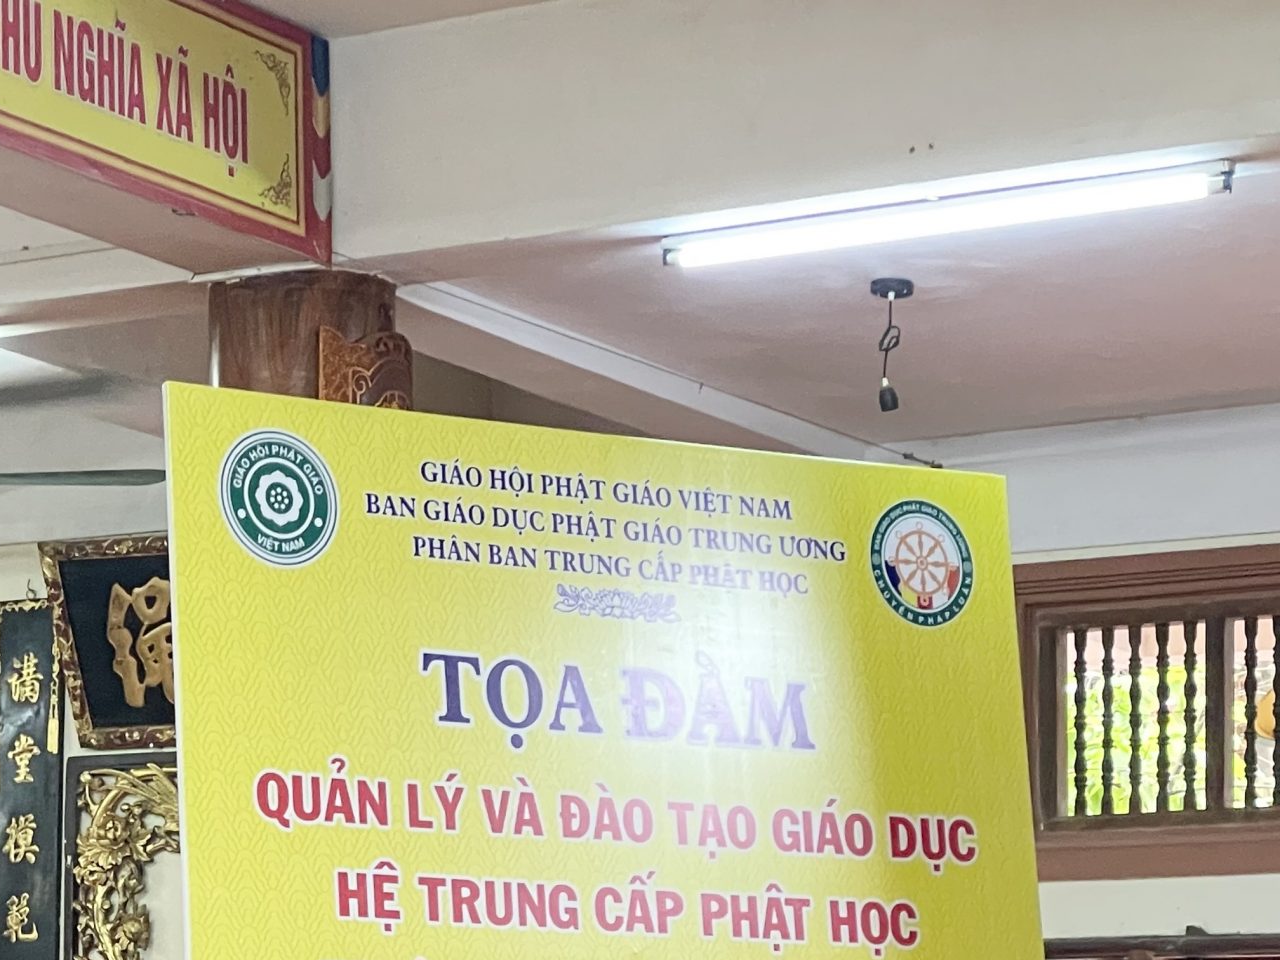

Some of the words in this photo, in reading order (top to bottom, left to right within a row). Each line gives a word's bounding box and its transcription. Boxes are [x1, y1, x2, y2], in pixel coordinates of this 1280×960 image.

[53, 9, 146, 124] NGHĨA
[156, 46, 194, 143] XÃ
[203, 64, 248, 177] HỘI
[233, 457, 251, 488] GIÁO
[249, 444, 269, 461] HỘI
[271, 444, 304, 464] PHẬT
[303, 463, 323, 495] GIÁO
[421, 458, 482, 487] GIÁO
[489, 466, 534, 497] HỘI
[541, 473, 606, 504] PHẬT
[612, 479, 672, 508] GIÁO
[678, 487, 732, 518] VIỆT
[739, 496, 792, 520] NAM
[257, 533, 280, 551] VIỆT
[281, 537, 305, 552] NAM
[365, 493, 416, 518] BAN
[423, 497, 485, 525] GIÁO
[492, 507, 545, 535] DỤC
[552, 511, 616, 542] PHẬT
[624, 518, 682, 546] GIÁO
[688, 528, 772, 554] TRUNG
[779, 535, 846, 561] ƯƠNG
[413, 534, 480, 562] PHÂN
[488, 544, 537, 568] BAN
[544, 549, 631, 577] TRUNG
[638, 550, 682, 583] CẤP
[759, 570, 809, 597] HỌC
[422, 652, 604, 749] TỌA
[621, 650, 816, 750] ĐÀM
[256, 758, 389, 829] QUẢN
[407, 773, 464, 830] LÝ
[481, 776, 544, 836] VÀ
[559, 782, 653, 842] ĐÀO
[667, 801, 756, 859] TẠO
[772, 798, 874, 857] GIÁO
[889, 816, 976, 871] DỤC
[338, 861, 401, 932] HỆ
[418, 876, 579, 930] TRUNG
[595, 870, 684, 934] CẤP
[700, 883, 810, 951] PHẬT
[829, 900, 918, 956] HỌC
